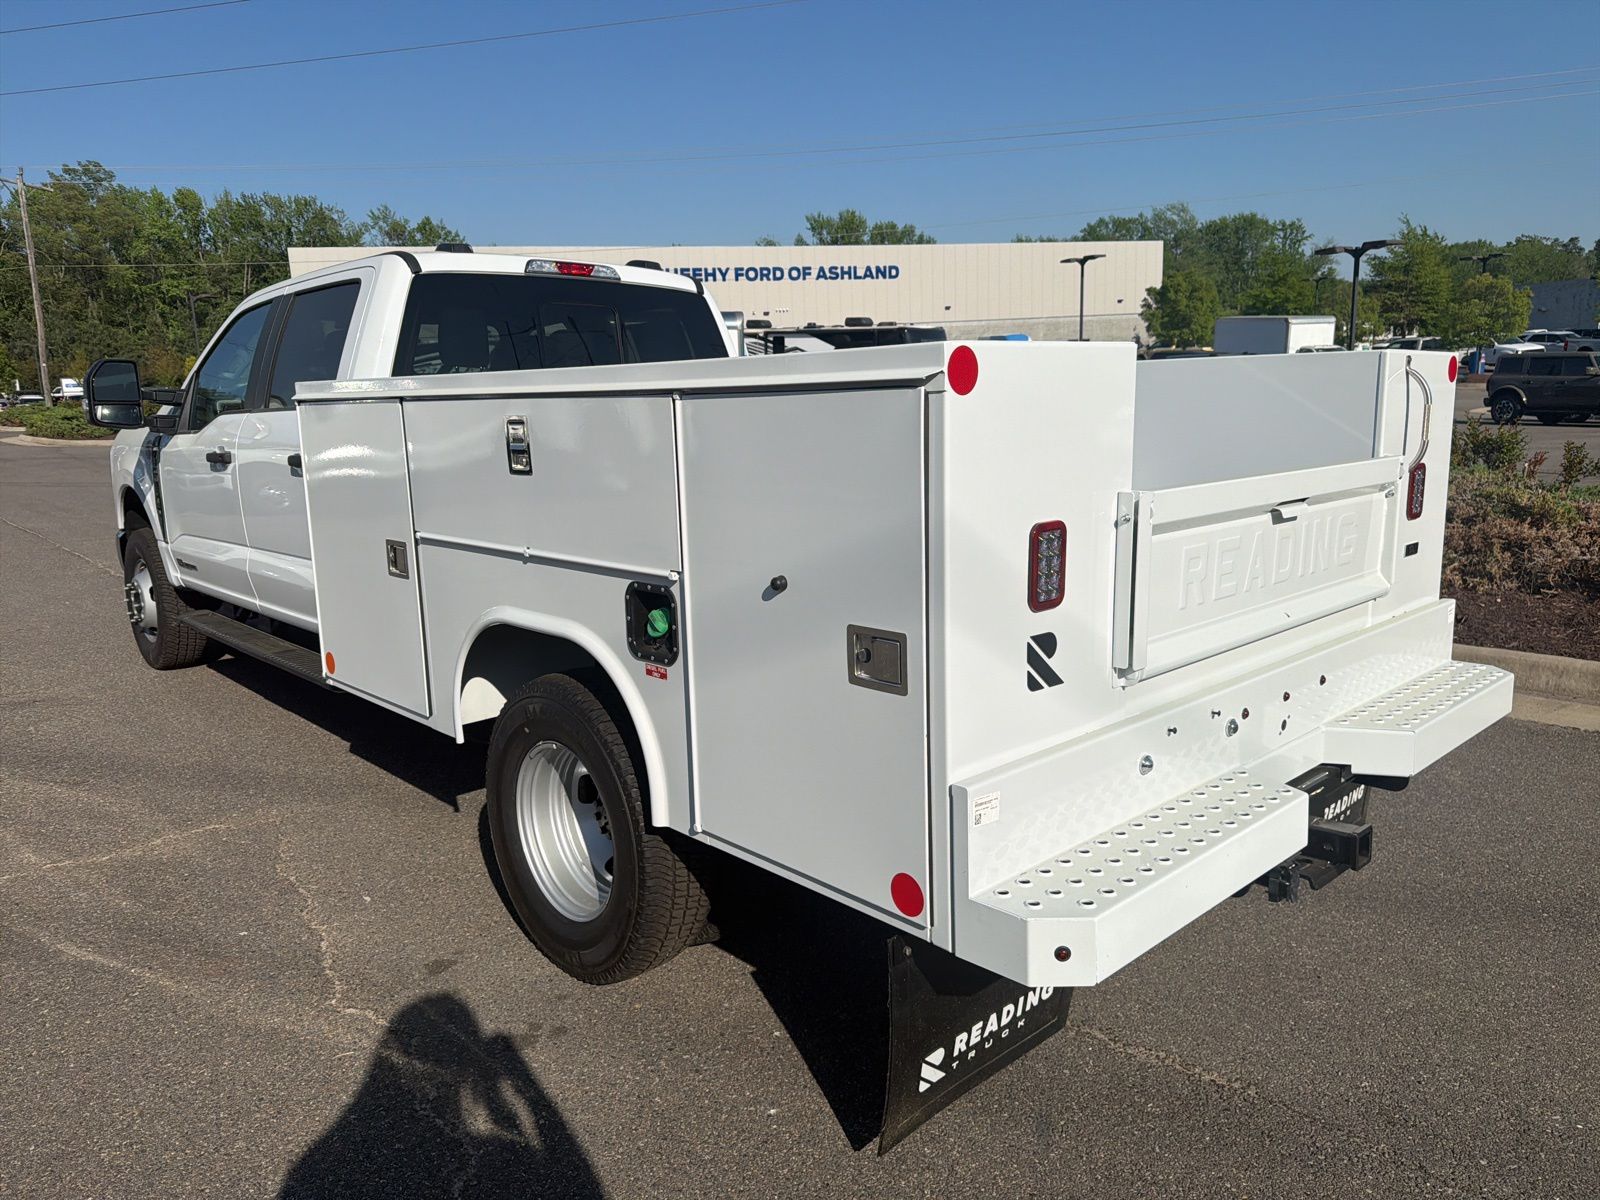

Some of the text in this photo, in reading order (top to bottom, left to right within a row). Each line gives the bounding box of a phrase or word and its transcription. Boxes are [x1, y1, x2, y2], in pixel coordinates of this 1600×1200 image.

[734, 266, 784, 282] FORD
[788, 266, 812, 281] OF
[816, 265, 900, 280] ASHLAND
[1178, 511, 1358, 611] READING
[951, 1018, 1026, 1070] TRUCK
[953, 986, 1054, 1057] READING
